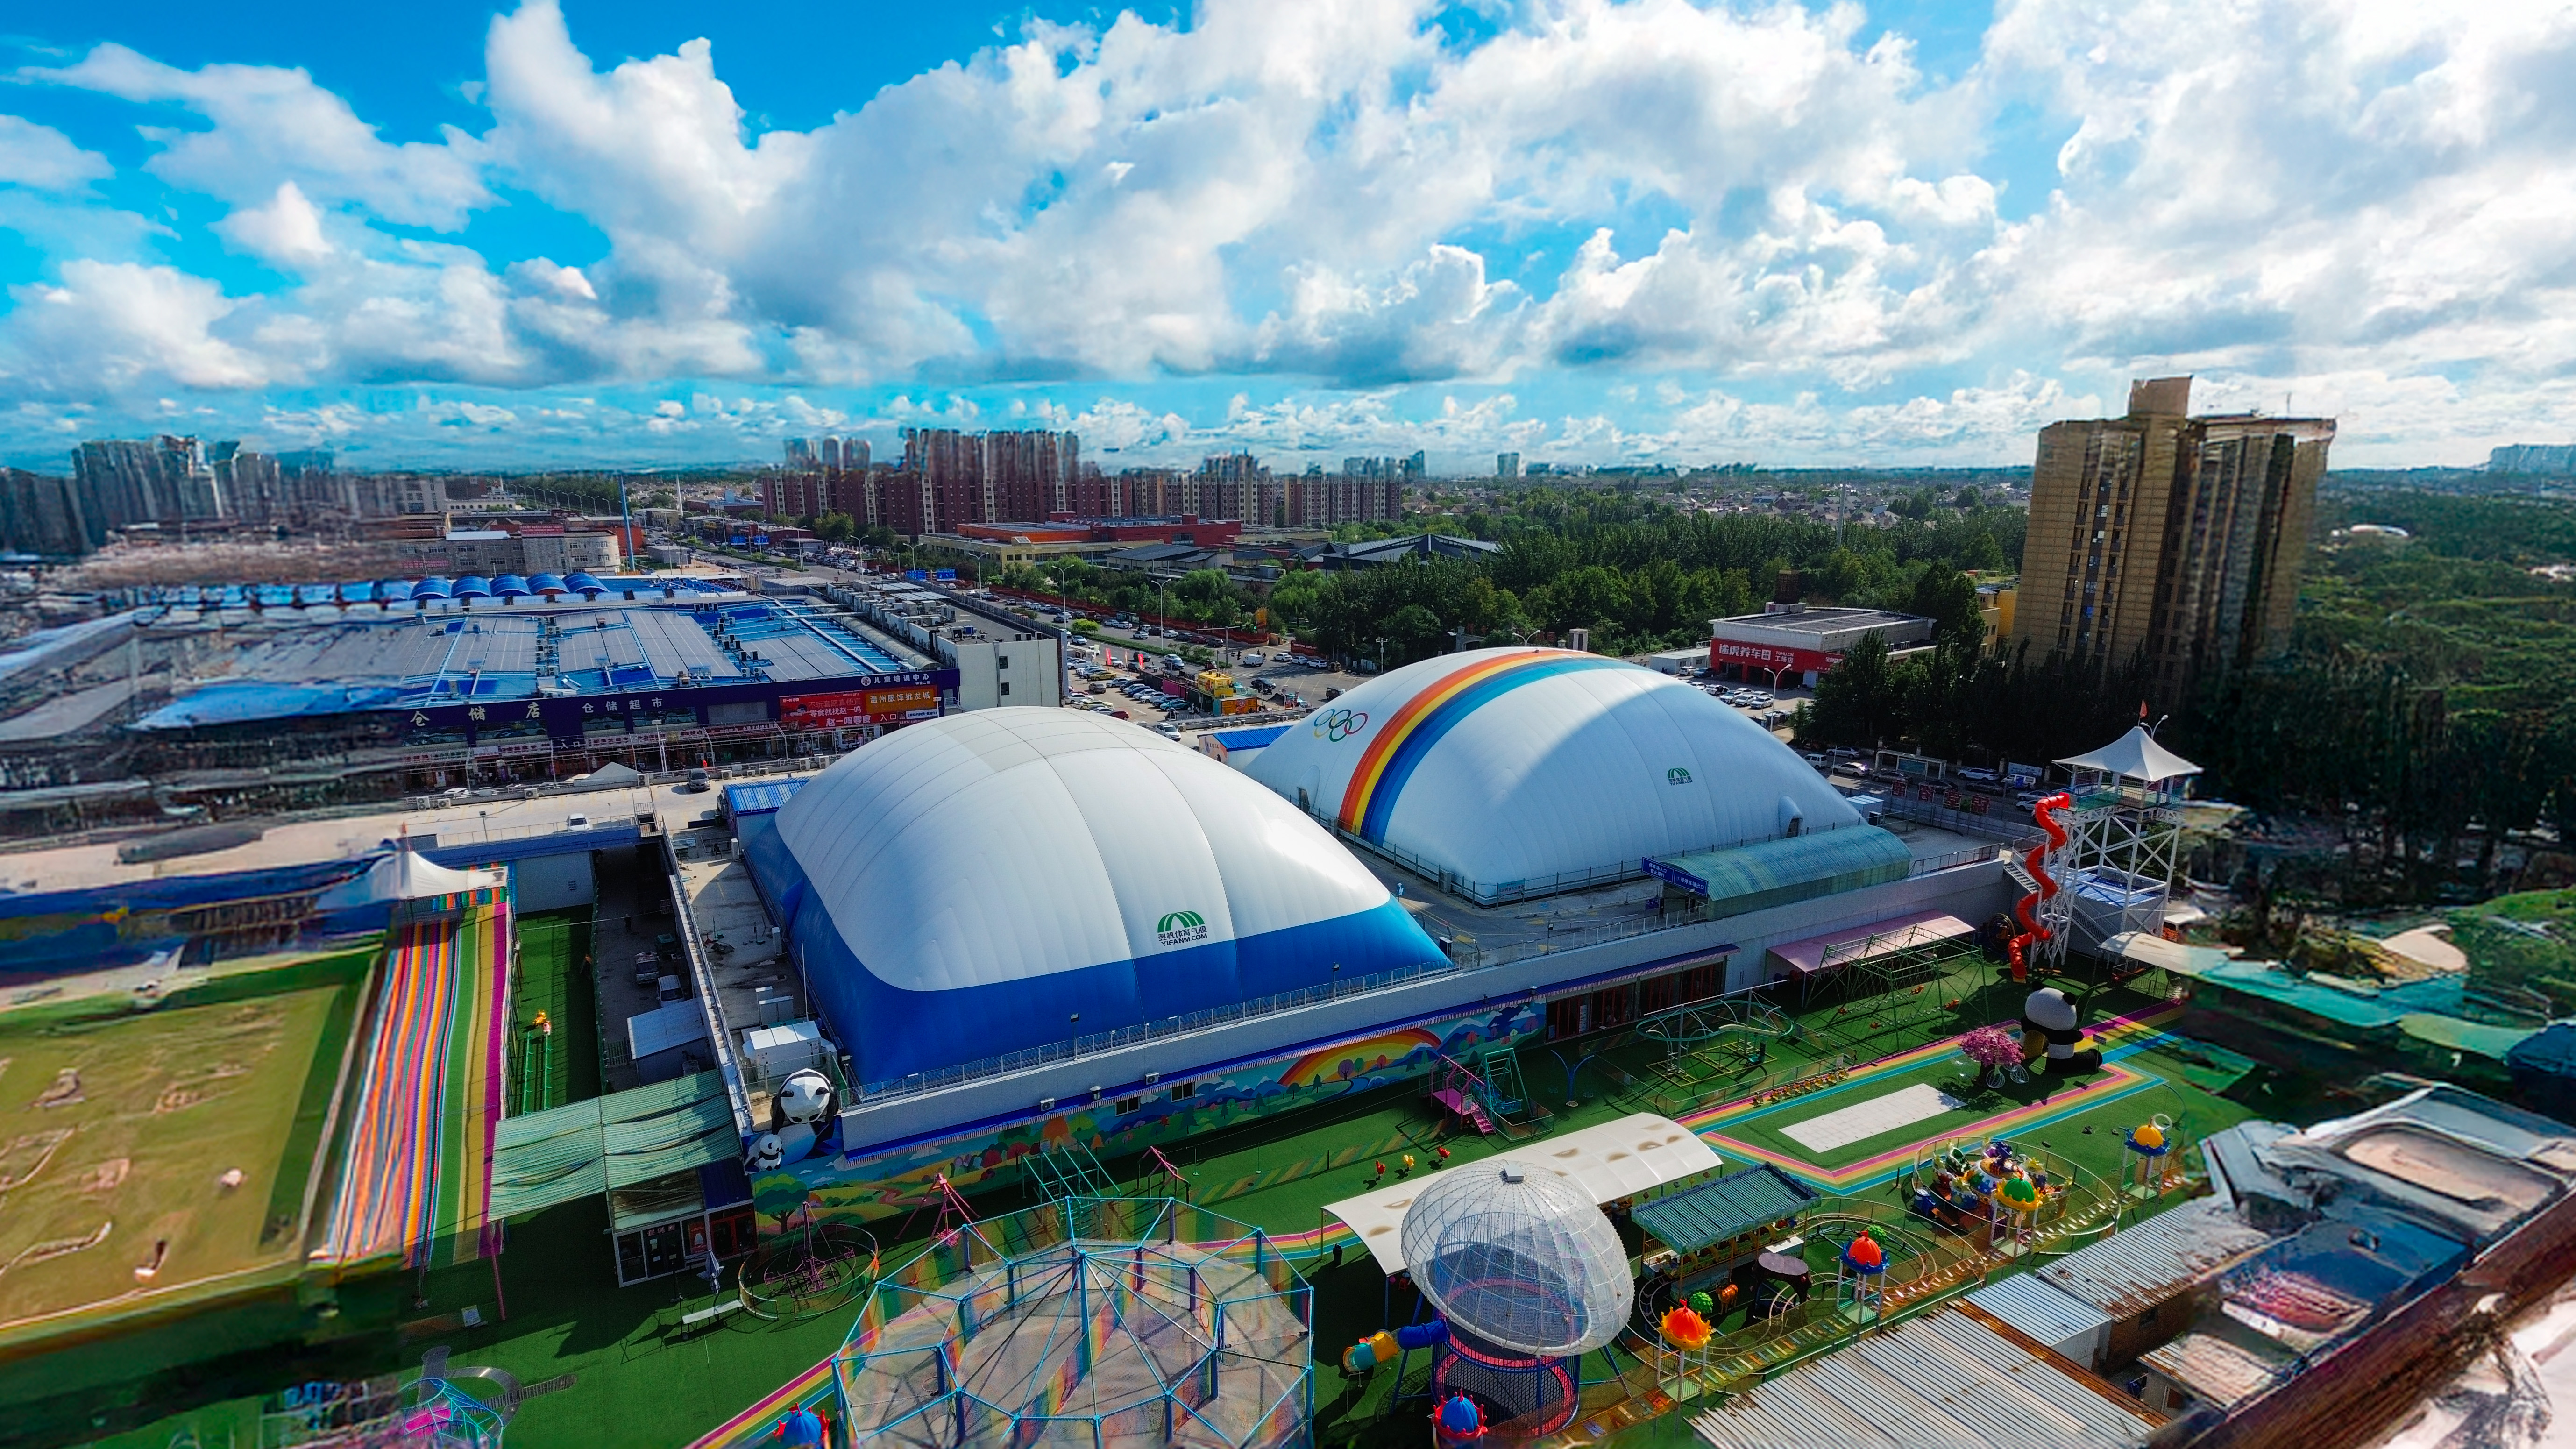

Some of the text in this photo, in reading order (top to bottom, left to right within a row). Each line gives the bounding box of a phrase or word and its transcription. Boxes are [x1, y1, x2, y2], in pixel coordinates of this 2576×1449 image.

[1719, 644, 1761, 659] 途虎养车
[874, 673, 930, 684] 儿童培训中心
[870, 691, 930, 703] 温州服饰批发城
[582, 697, 663, 713] 仓储超市
[410, 702, 540, 726] 仓储店
[810, 706, 861, 717] 零食就找赵一鸣
[826, 715, 871, 727] 赵一鸣零食
[1649, 863, 1667, 874] 停车场入口
[1157, 925, 1207, 941] 翌帆体育气膜
[1161, 933, 1207, 946] YIFANM.COM
